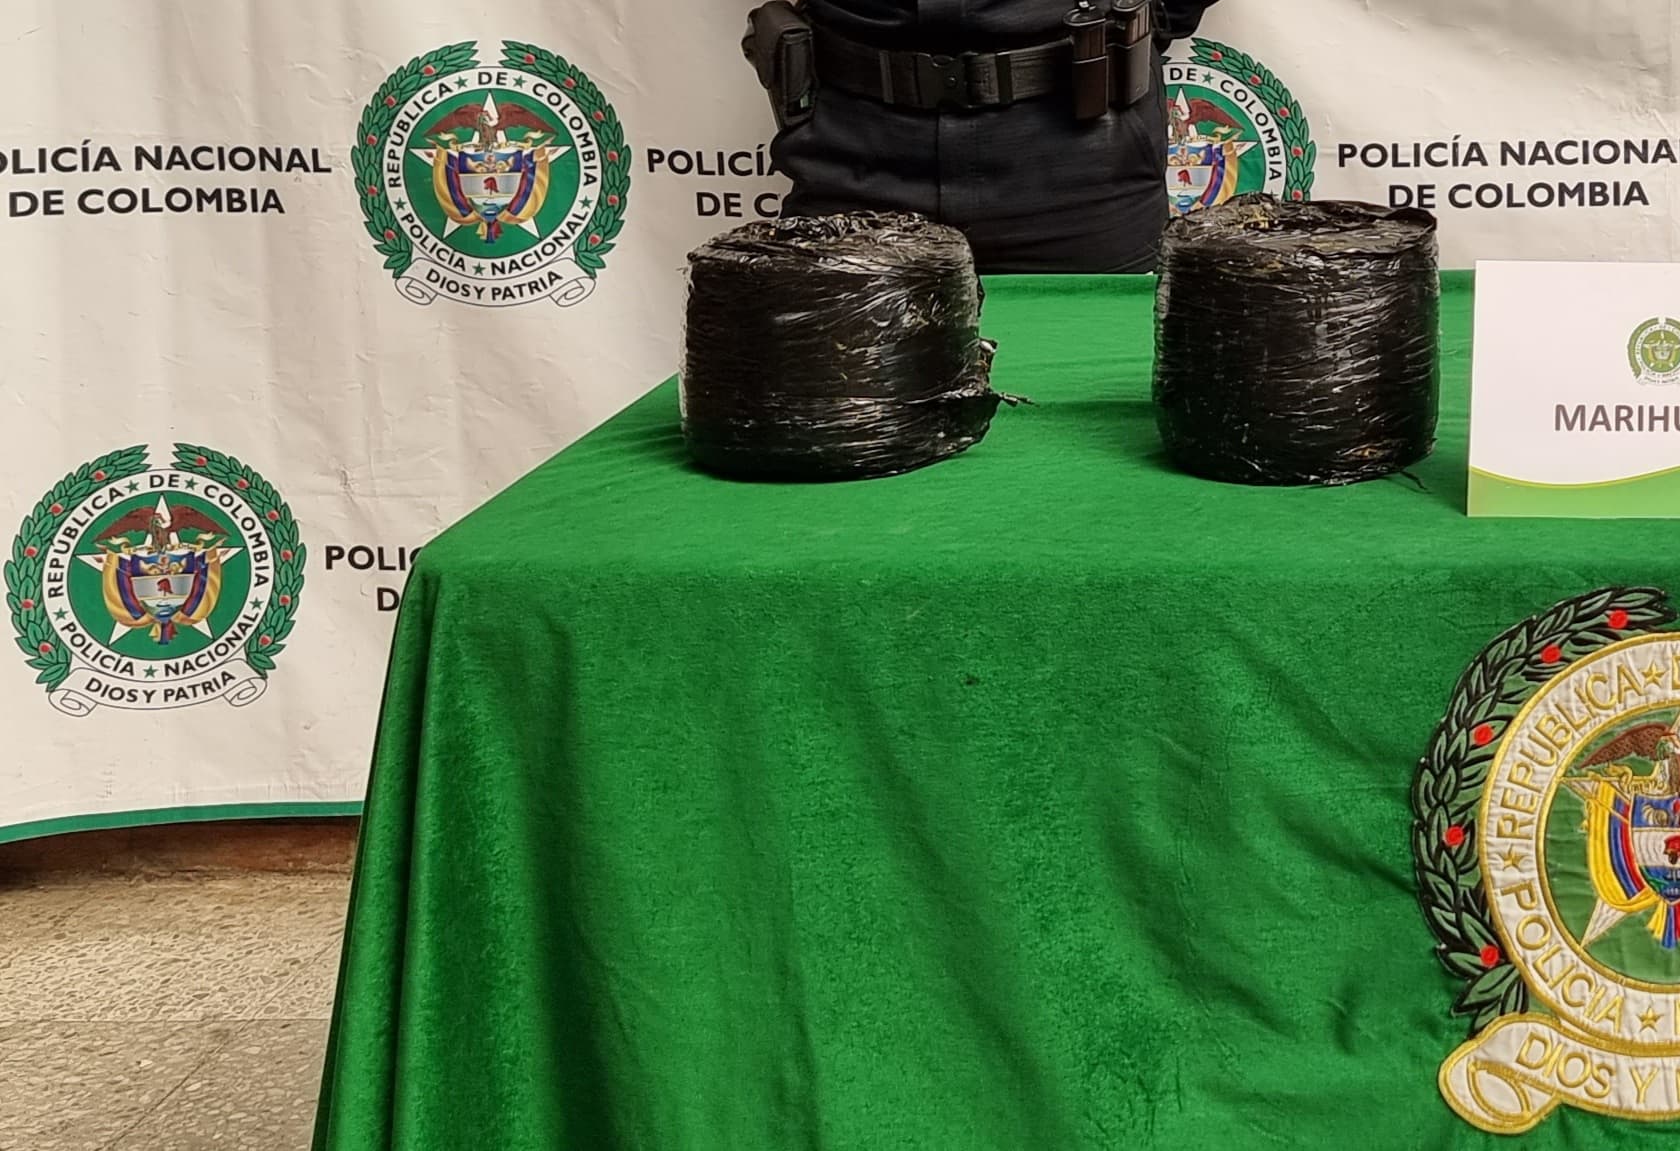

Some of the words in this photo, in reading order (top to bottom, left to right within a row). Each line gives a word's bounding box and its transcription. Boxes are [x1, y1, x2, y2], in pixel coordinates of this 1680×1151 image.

[0, 140, 121, 174] LICÍA
[134, 145, 332, 174] NACIONAL
[648, 144, 776, 176] POLICÍ
[1338, 135, 1489, 169] POLICÍA
[9, 189, 65, 218] DE
[77, 187, 286, 215] COLOMBIA
[696, 191, 743, 218] DE
[1387, 183, 1436, 210] DE
[1447, 180, 1650, 209] COLOMBIA
[150, 475, 180, 488] DE
[204, 486, 268, 587] COLOMBIA
[164, 614, 258, 677] NACIONAL
[85, 678, 139, 701] DIOS
[164, 671, 236, 702] PATRIA
[1517, 1032, 1615, 1097] DIOS
